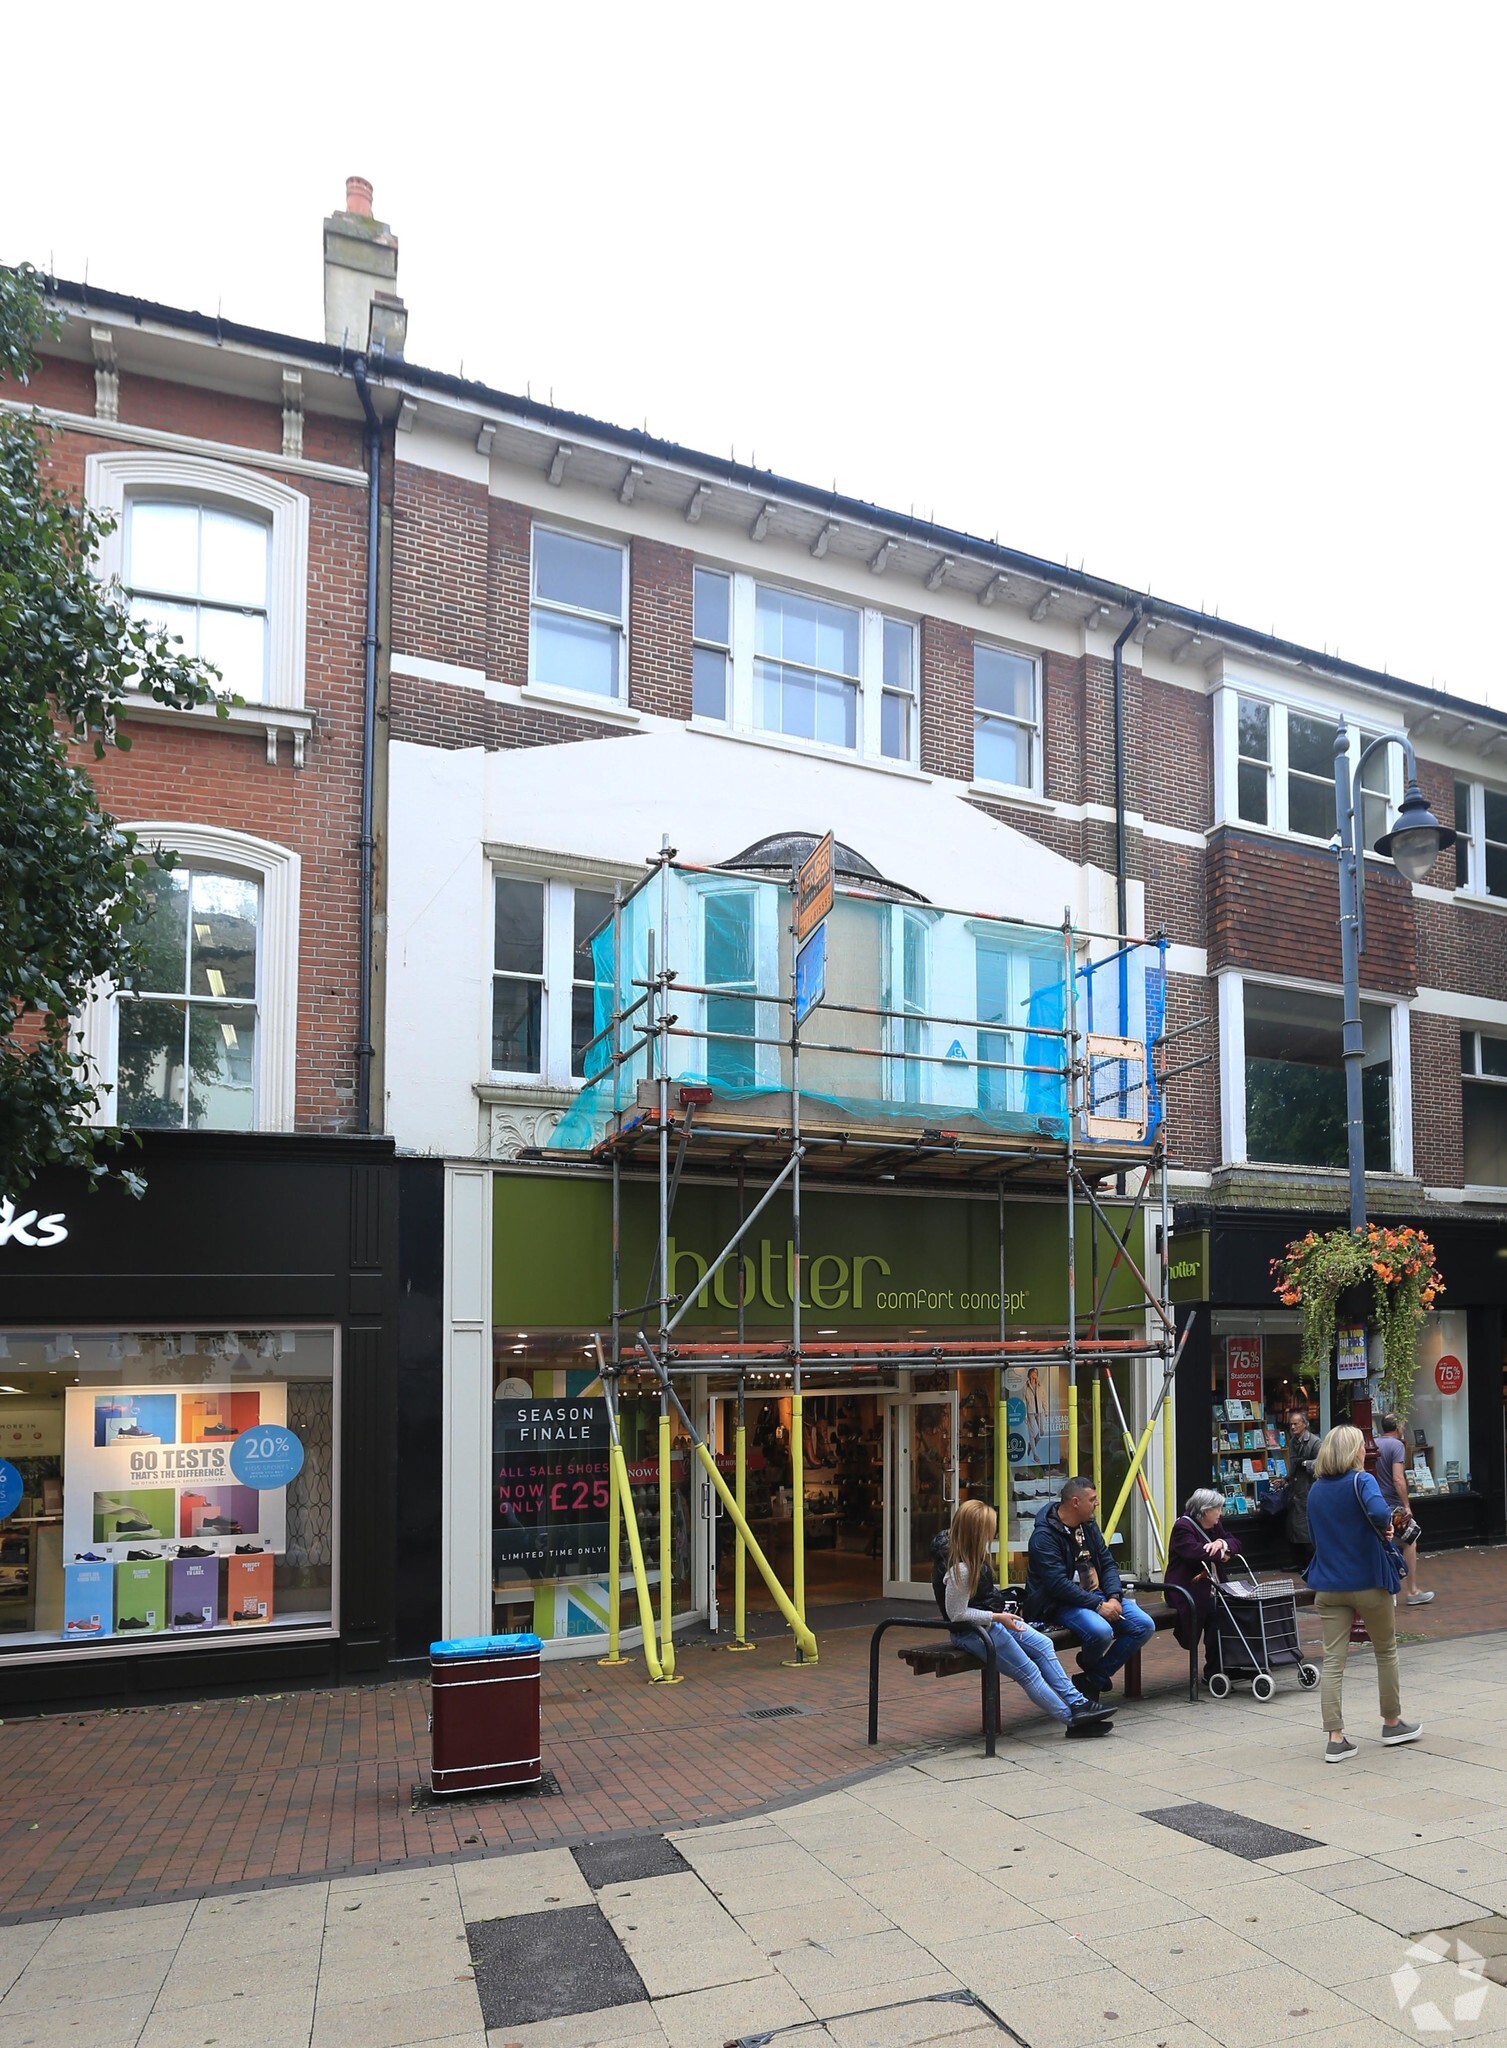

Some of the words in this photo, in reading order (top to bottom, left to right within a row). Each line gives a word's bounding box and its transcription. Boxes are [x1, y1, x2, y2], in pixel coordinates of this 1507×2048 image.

[0, 1195, 68, 1247] ks
[667, 1237, 891, 1309] hotter
[877, 1289, 954, 1310] comfort
[1242, 1389, 1256, 1397] Gifts
[517, 1408, 594, 1422] SEASON
[520, 1426, 590, 1441] FINALE
[130, 1451, 158, 1471] 60
[131, 1471, 159, 1480] THAT'S
[161, 1470, 176, 1479] THE
[499, 1468, 524, 1478] ALL
[529, 1465, 562, 1477] SALE
[567, 1463, 609, 1475] SHOES
[628, 1468, 653, 1478] NOW
[500, 1484, 544, 1499] NOW
[550, 1480, 609, 1511] £25
[500, 1500, 544, 1514] ONLY
[502, 1551, 544, 1561] LIMITED
[549, 1549, 573, 1557] TIME
[578, 1546, 607, 1555] ONLY!
